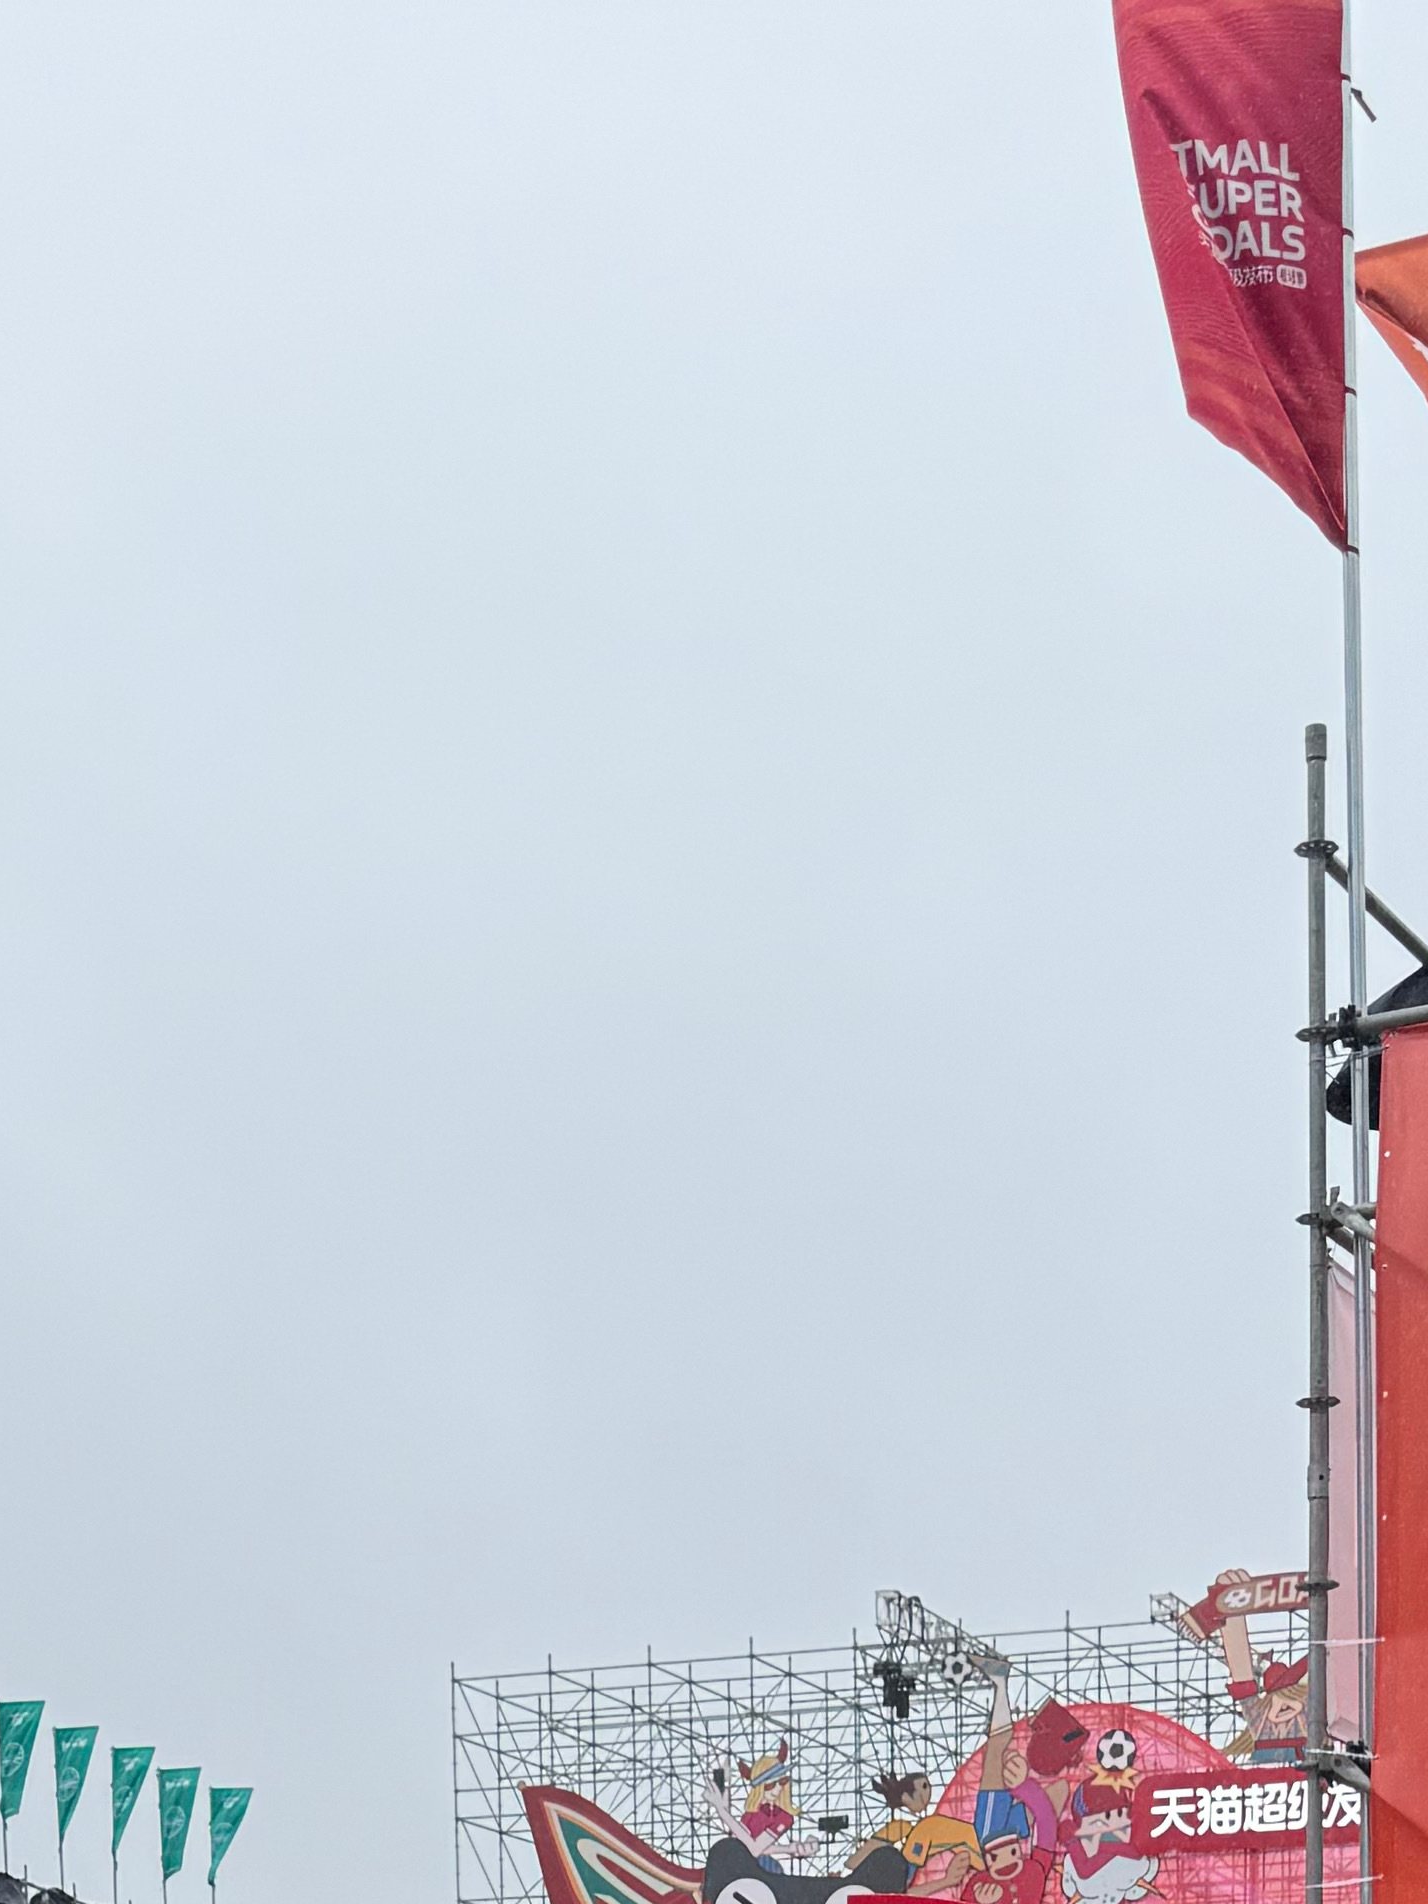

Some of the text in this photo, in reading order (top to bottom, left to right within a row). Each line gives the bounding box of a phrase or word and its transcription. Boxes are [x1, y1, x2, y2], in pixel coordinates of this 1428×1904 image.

[1169, 138, 1300, 182] TMALL
[1188, 179, 1305, 223] UPER
[1194, 218, 1306, 264] OALS
